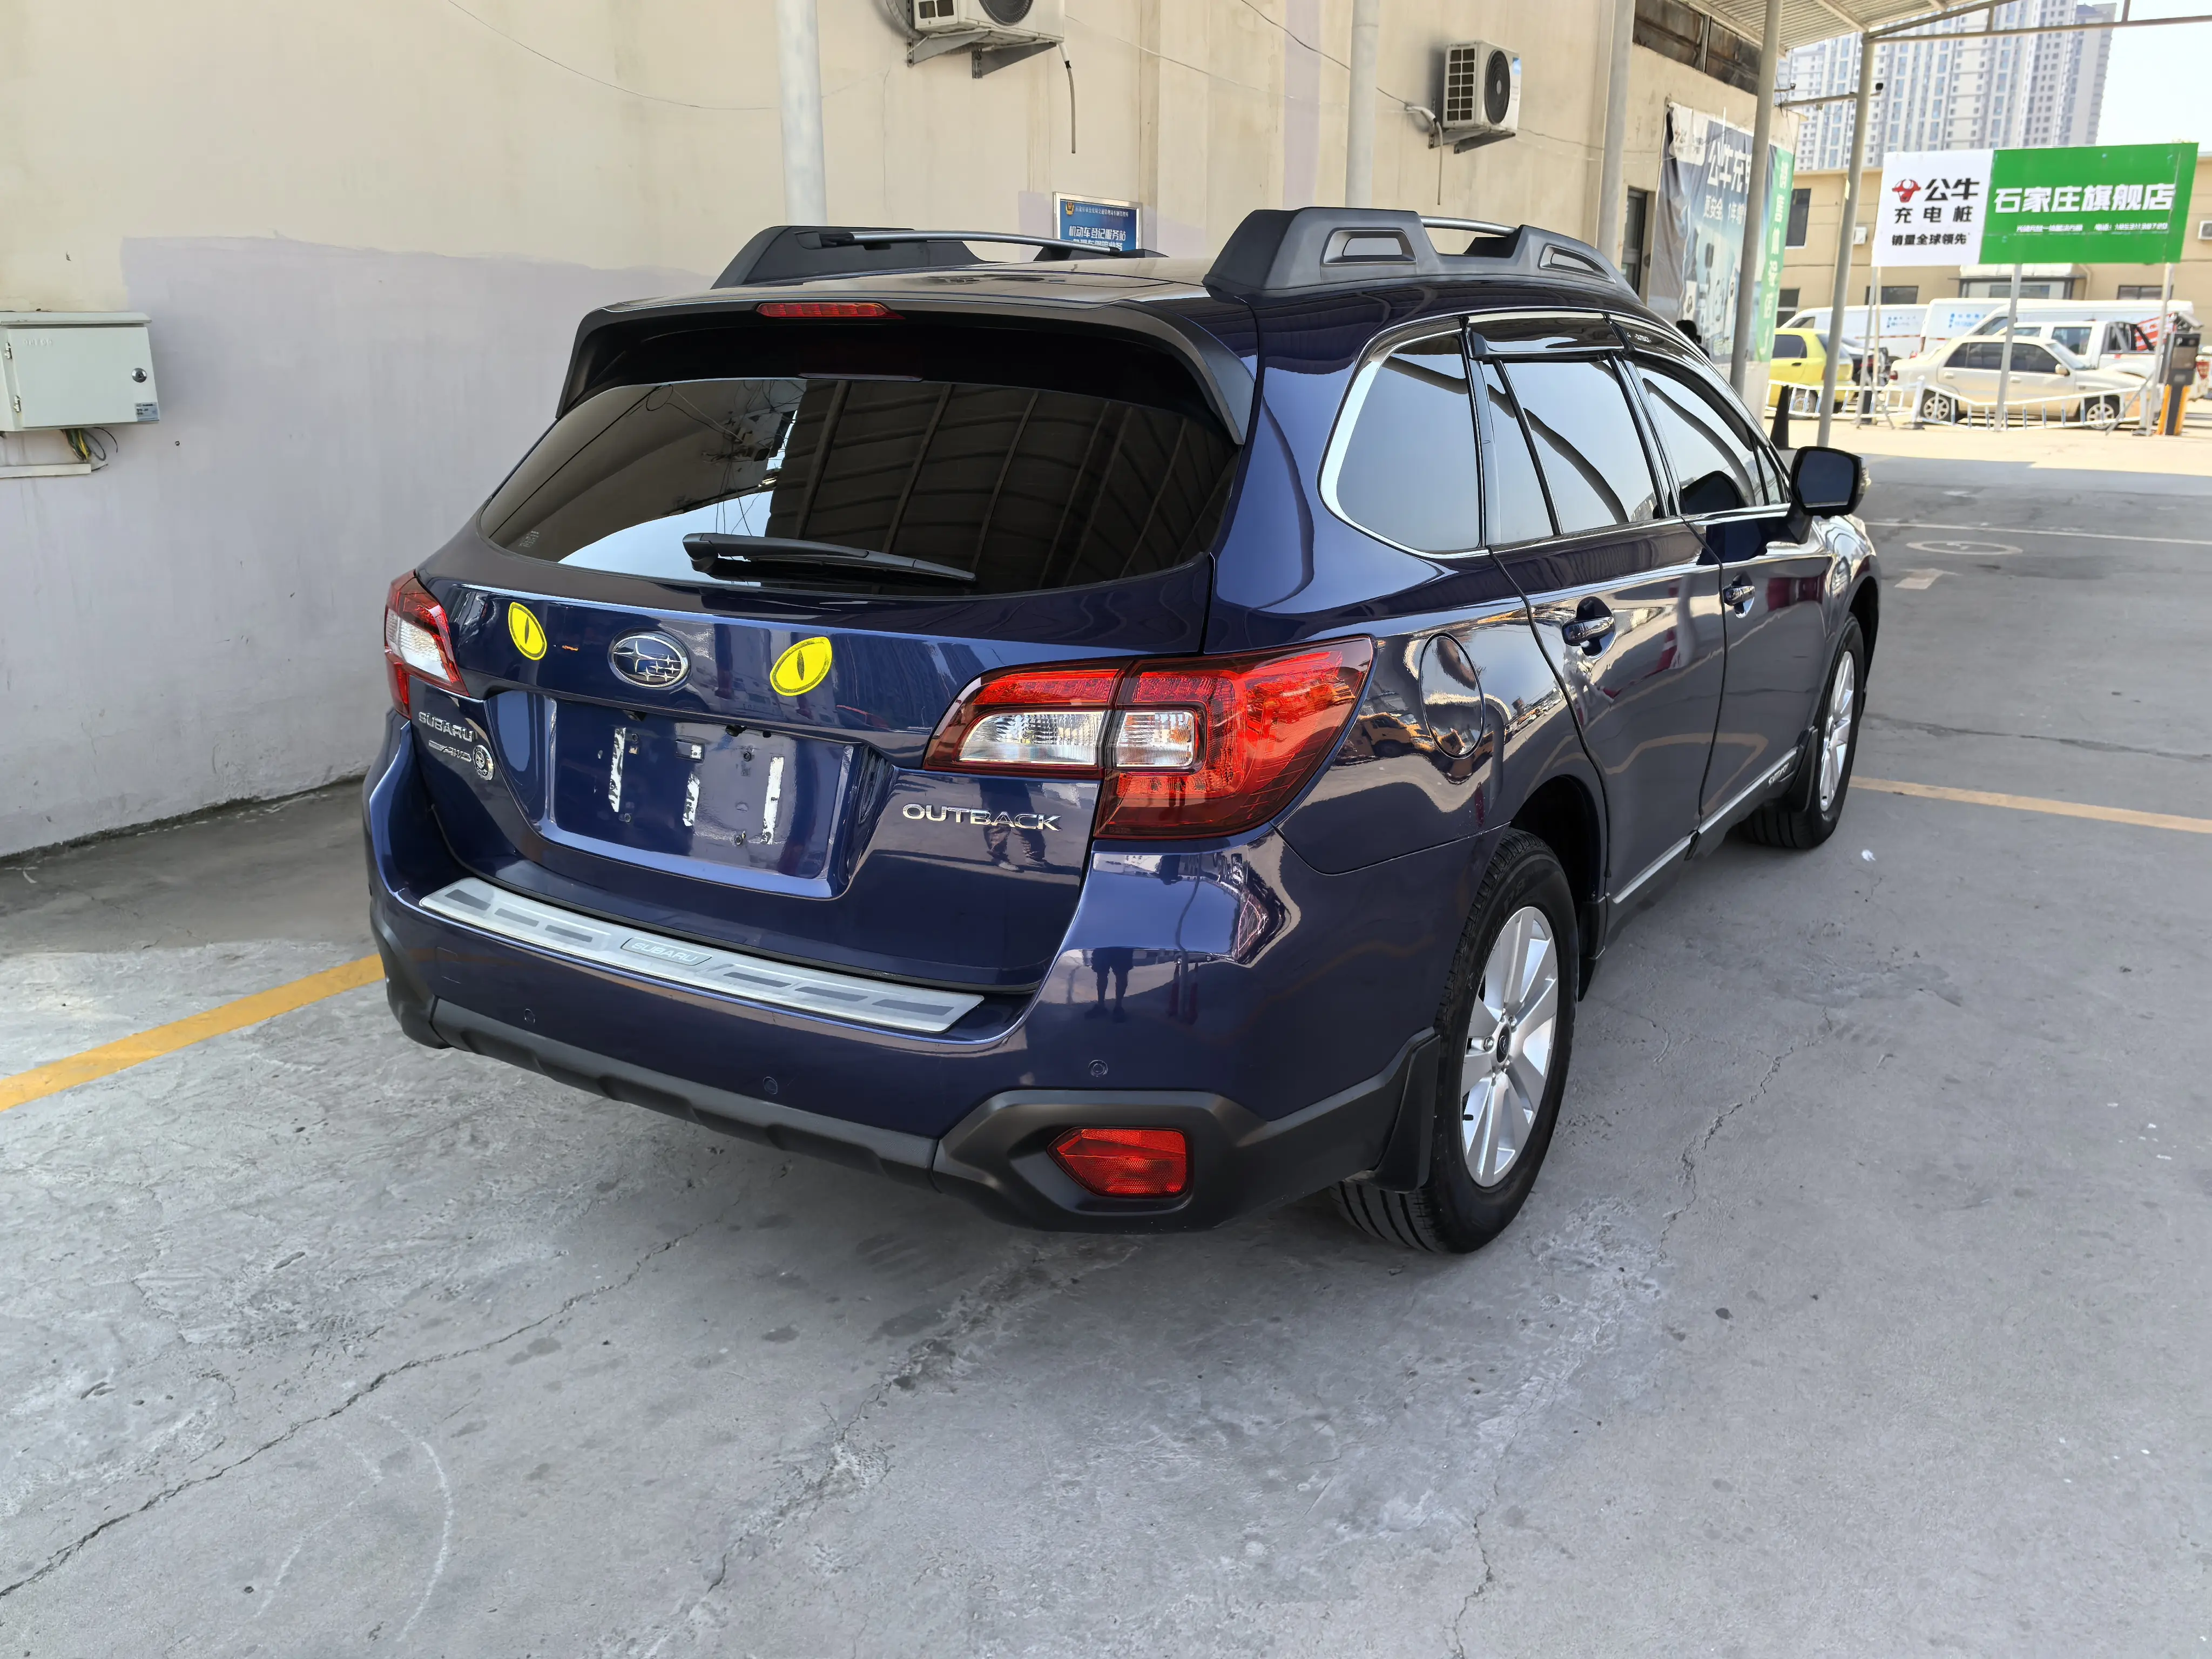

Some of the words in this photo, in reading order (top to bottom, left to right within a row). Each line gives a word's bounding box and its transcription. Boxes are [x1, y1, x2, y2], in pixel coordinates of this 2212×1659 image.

[1924, 177, 1980, 201] 公牛
[1993, 184, 2175, 213] 石家庄旗舰店
[1894, 206, 1973, 224] 充电桩
[1069, 225, 1127, 241] 机动车登记服务站
[1891, 233, 1967, 246] 销量全球领先
[419, 711, 473, 743] SUBARU
[443, 746, 472, 763] AWD
[902, 802, 1062, 832] OUTBACK
[631, 942, 699, 962] SUBARU
